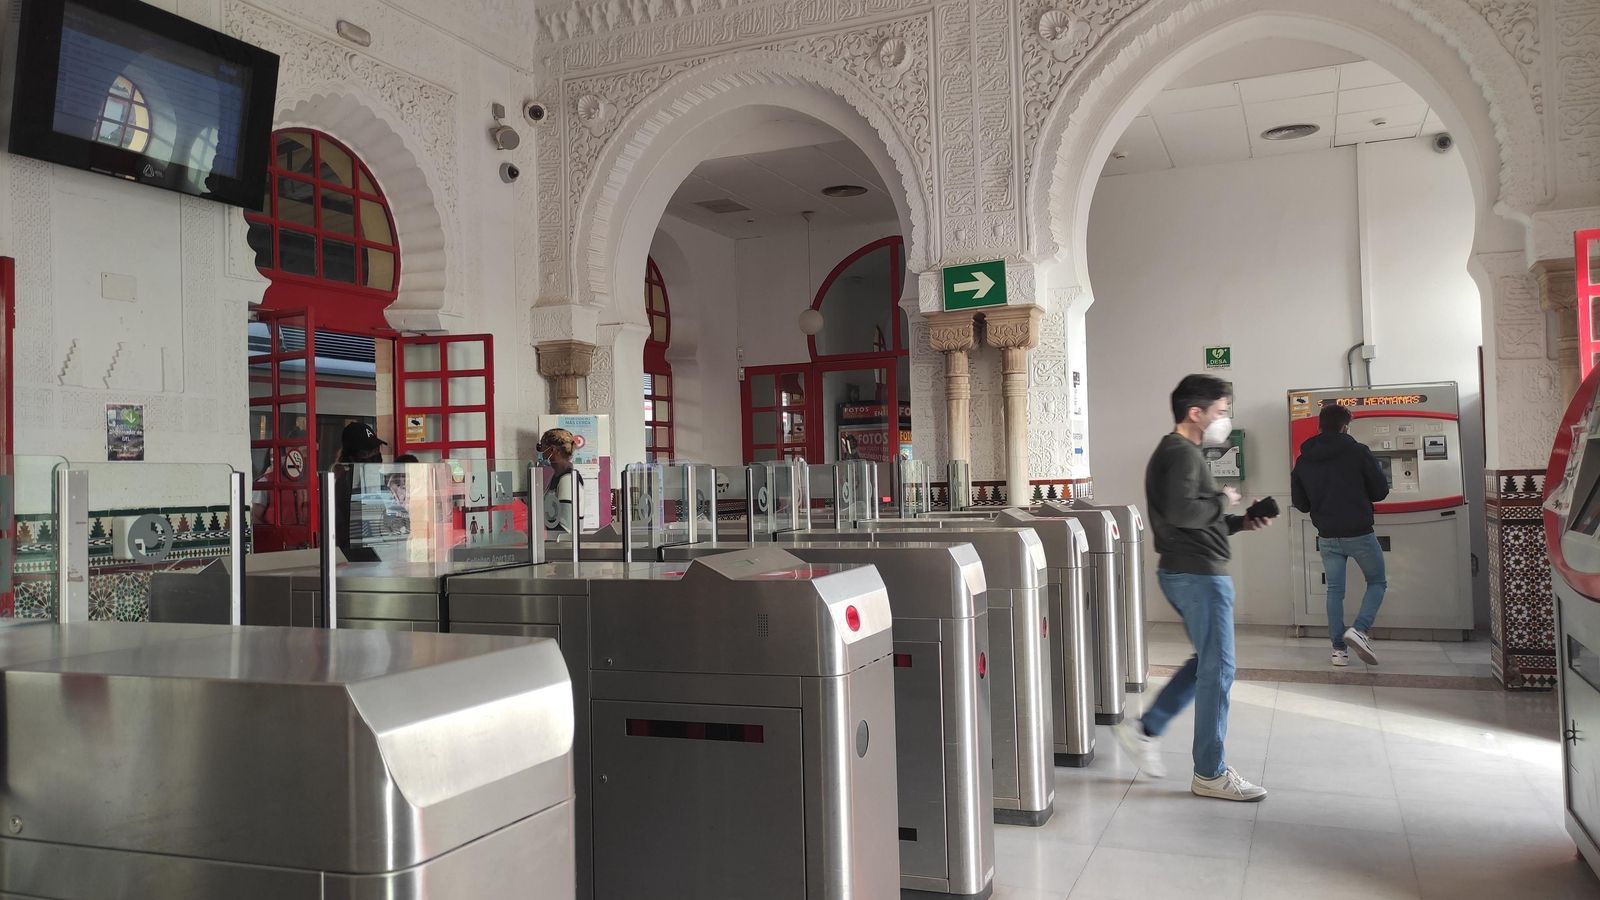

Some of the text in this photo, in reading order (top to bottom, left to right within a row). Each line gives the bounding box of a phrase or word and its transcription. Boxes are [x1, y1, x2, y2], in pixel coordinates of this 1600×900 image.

[1336, 398, 1358, 406] DOS
[1363, 395, 1420, 405] HERMANAS
[365, 428, 374, 438] A
[858, 432, 889, 444] FOTOS
